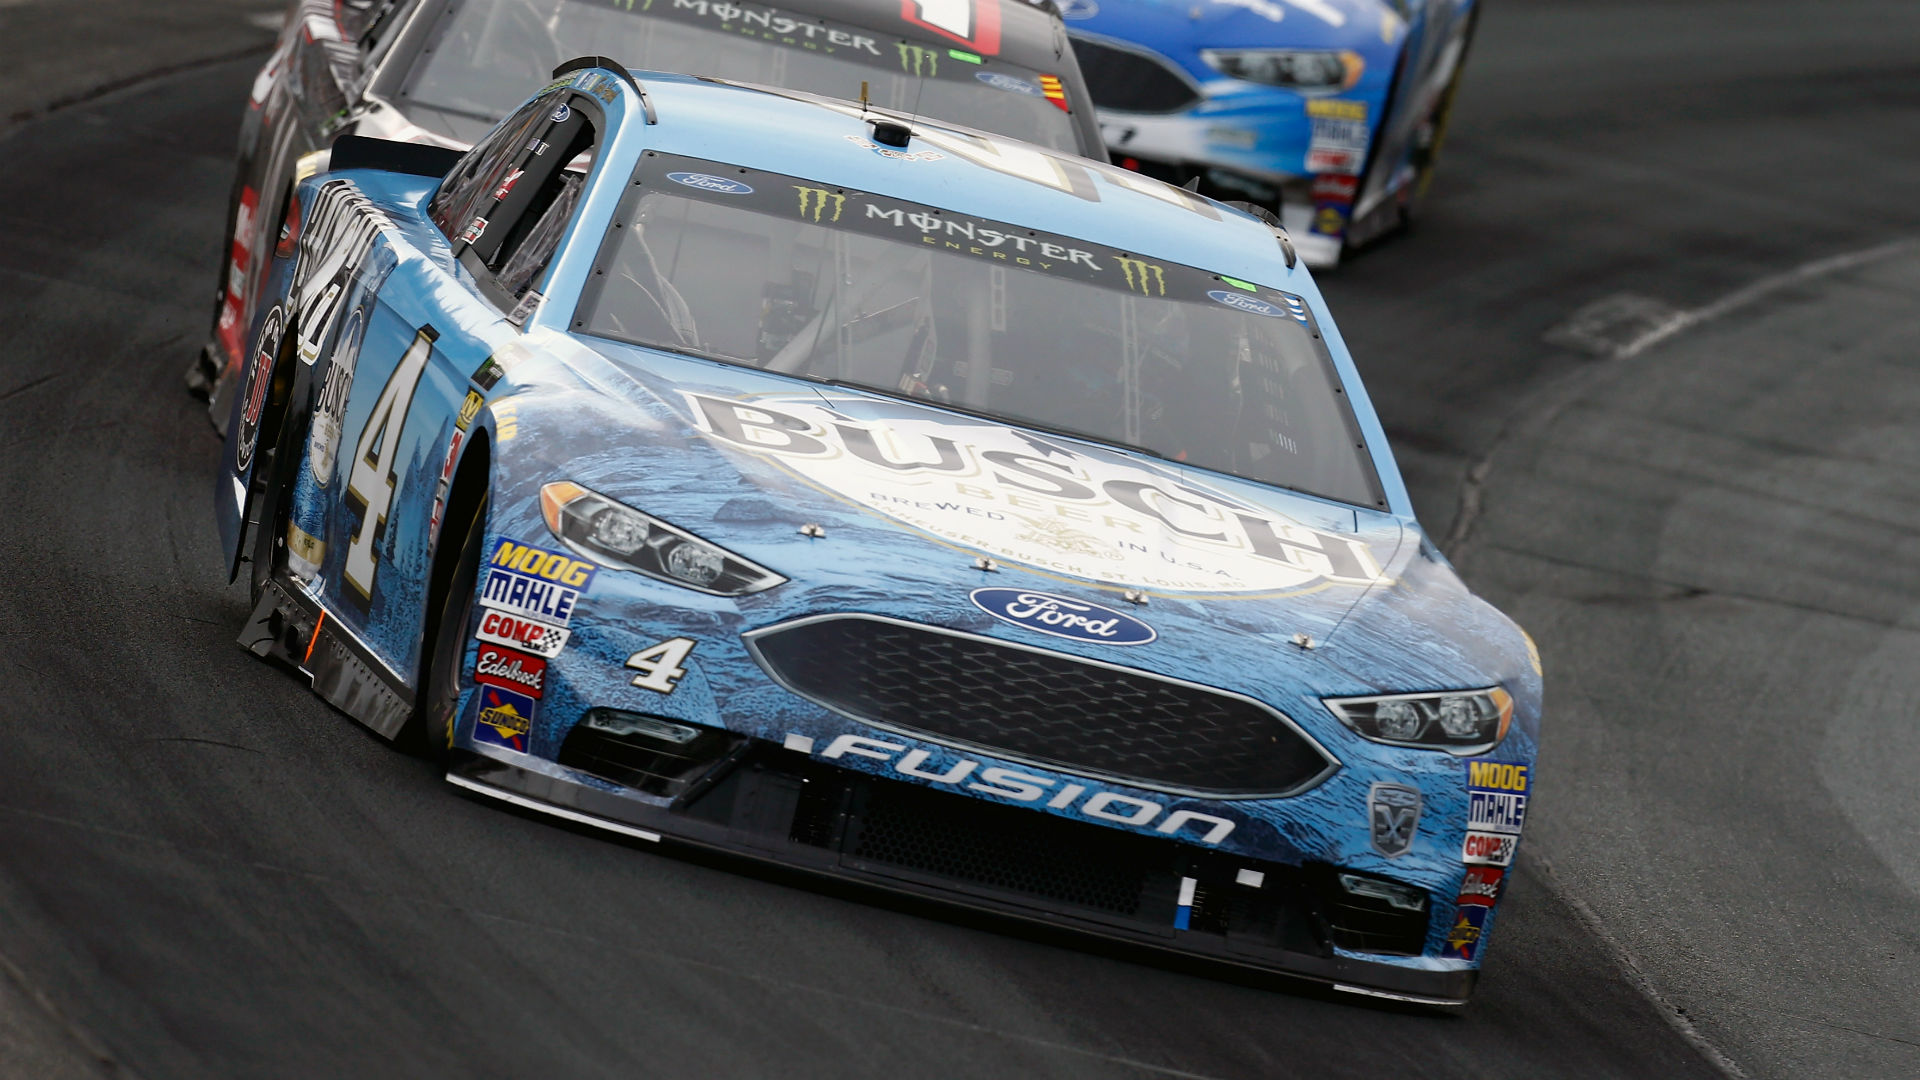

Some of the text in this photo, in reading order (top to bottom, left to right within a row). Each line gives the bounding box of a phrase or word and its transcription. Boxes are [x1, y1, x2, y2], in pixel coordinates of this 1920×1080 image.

[673, 0, 882, 56] MONSTER
[865, 203, 1103, 271] MONSTER
[922, 236, 1052, 270] ENERGY
[342, 324, 440, 612] 4
[688, 391, 1376, 582] BUSCH
[954, 482, 1145, 534] BEER
[870, 492, 1242, 581] BREWED IN U.S.A.
[490, 541, 596, 587] MOOG
[483, 570, 577, 620] MAHLE
[1005, 592, 1121, 638] Ford
[482, 613, 545, 643] COMP
[476, 650, 545, 690] Edelbrock
[624, 635, 698, 695] 4
[820, 733, 1236, 845] FUSION
[1469, 761, 1527, 791] MOOG
[1471, 793, 1525, 826] MAHLE
[1465, 834, 1502, 858] COMP
